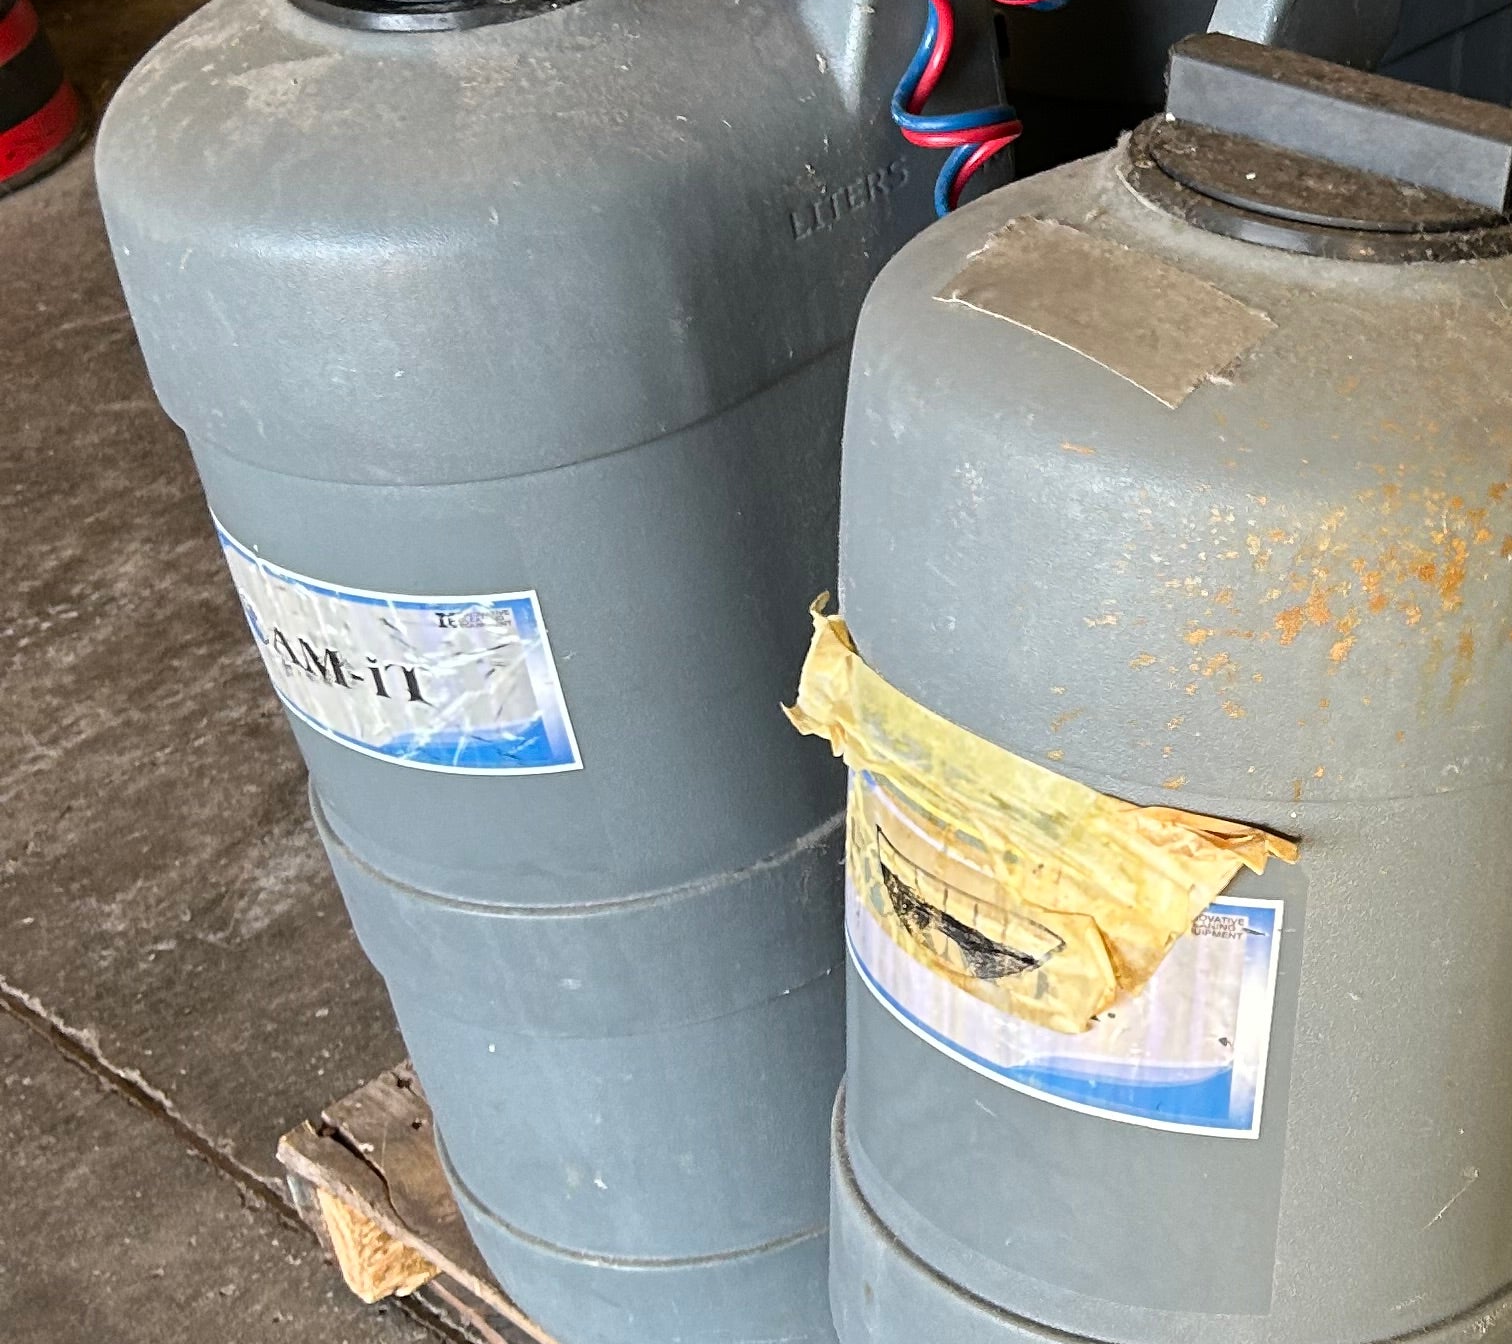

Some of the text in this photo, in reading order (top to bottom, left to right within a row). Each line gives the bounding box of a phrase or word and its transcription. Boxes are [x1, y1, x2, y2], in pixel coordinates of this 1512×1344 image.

[789, 159, 909, 241] LITERS
[1198, 914, 1245, 927] OVATIVE
[1193, 928, 1244, 940] UIPMENT
